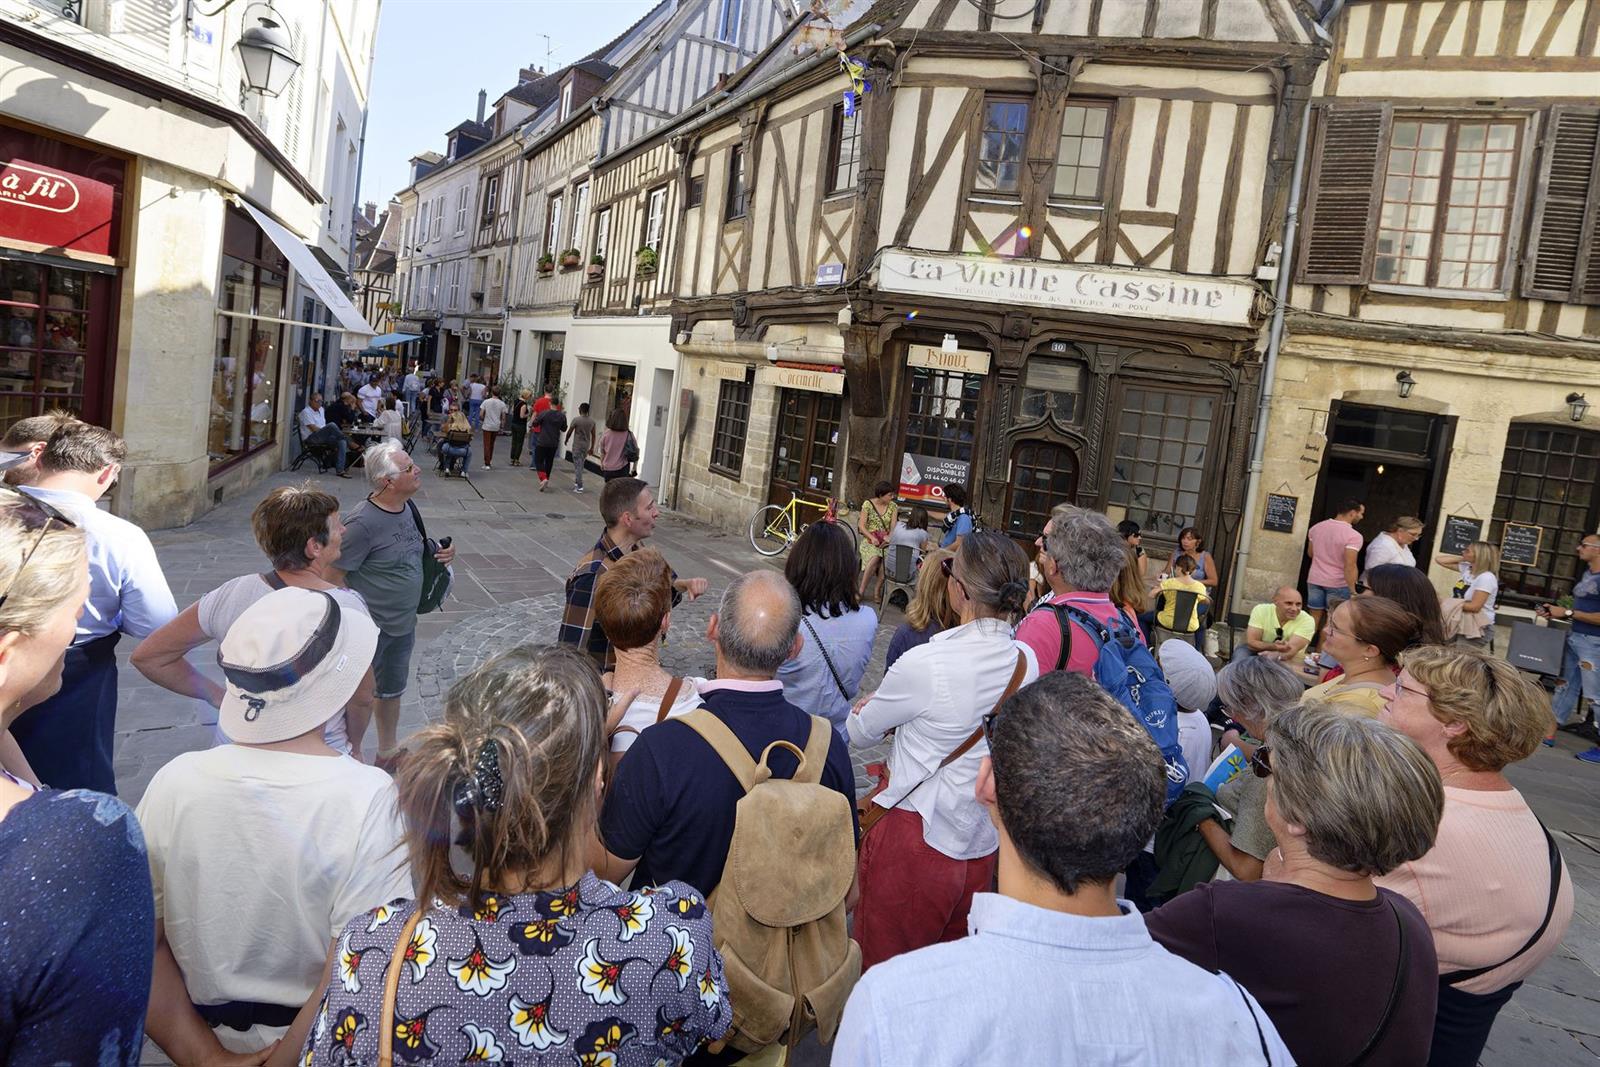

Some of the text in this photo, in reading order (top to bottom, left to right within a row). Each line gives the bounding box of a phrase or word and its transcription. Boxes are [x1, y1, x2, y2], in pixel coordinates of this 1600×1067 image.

[1, 173, 21, 190] à
[908, 257, 1223, 308] La Vieille Cassine
[1053, 343, 1066, 351] 10
[778, 369, 823, 388] Coccinelle
[926, 466, 966, 477] DISPONIBLES
[940, 461, 967, 471] LOCAUX
[1144, 709, 1166, 722] OSPREY
